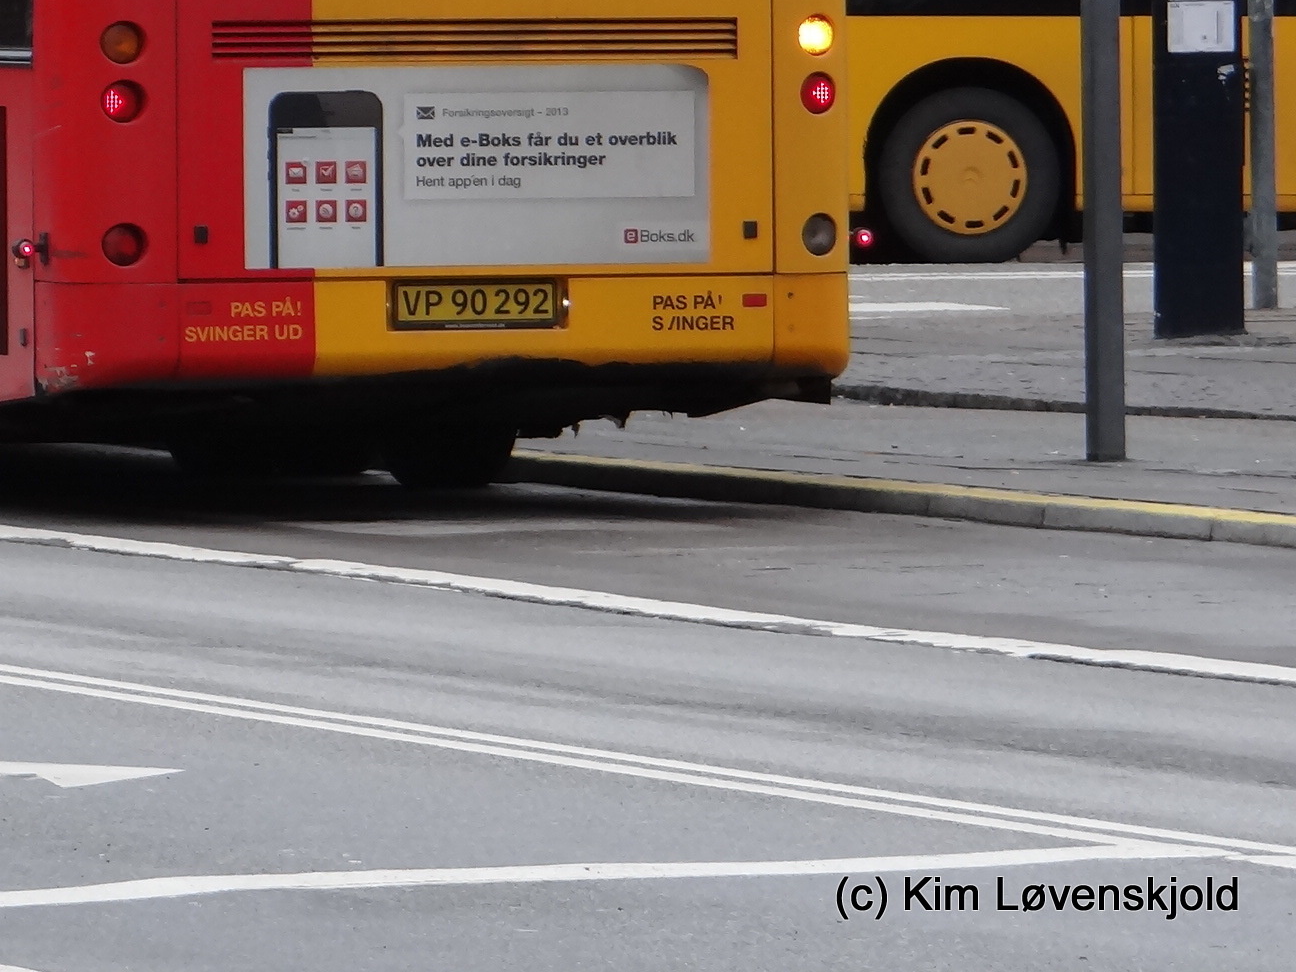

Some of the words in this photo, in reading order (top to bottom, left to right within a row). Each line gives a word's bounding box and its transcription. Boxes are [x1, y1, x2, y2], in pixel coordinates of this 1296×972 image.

[442, 108, 535, 119] Forsikringsoversigt
[546, 107, 569, 116] 2013
[416, 134, 454, 147] Med
[460, 133, 521, 147] e-Boks
[527, 131, 552, 146] får
[557, 132, 579, 146] du
[585, 132, 603, 146] et
[608, 131, 677, 146] overblik
[416, 156, 454, 166] over
[460, 153, 497, 166] dine
[503, 152, 606, 168] forsikringer
[416, 176, 445, 187] Hent
[498, 175, 522, 188] dag
[230, 302, 266, 317] PAS
[272, 296, 302, 316] PÅ!
[402, 291, 443, 316] VP
[451, 290, 488, 316] 90
[494, 289, 550, 315] 292
[653, 295, 688, 309] PAS
[184, 326, 269, 342] SVINGER
[274, 324, 303, 340] UD
